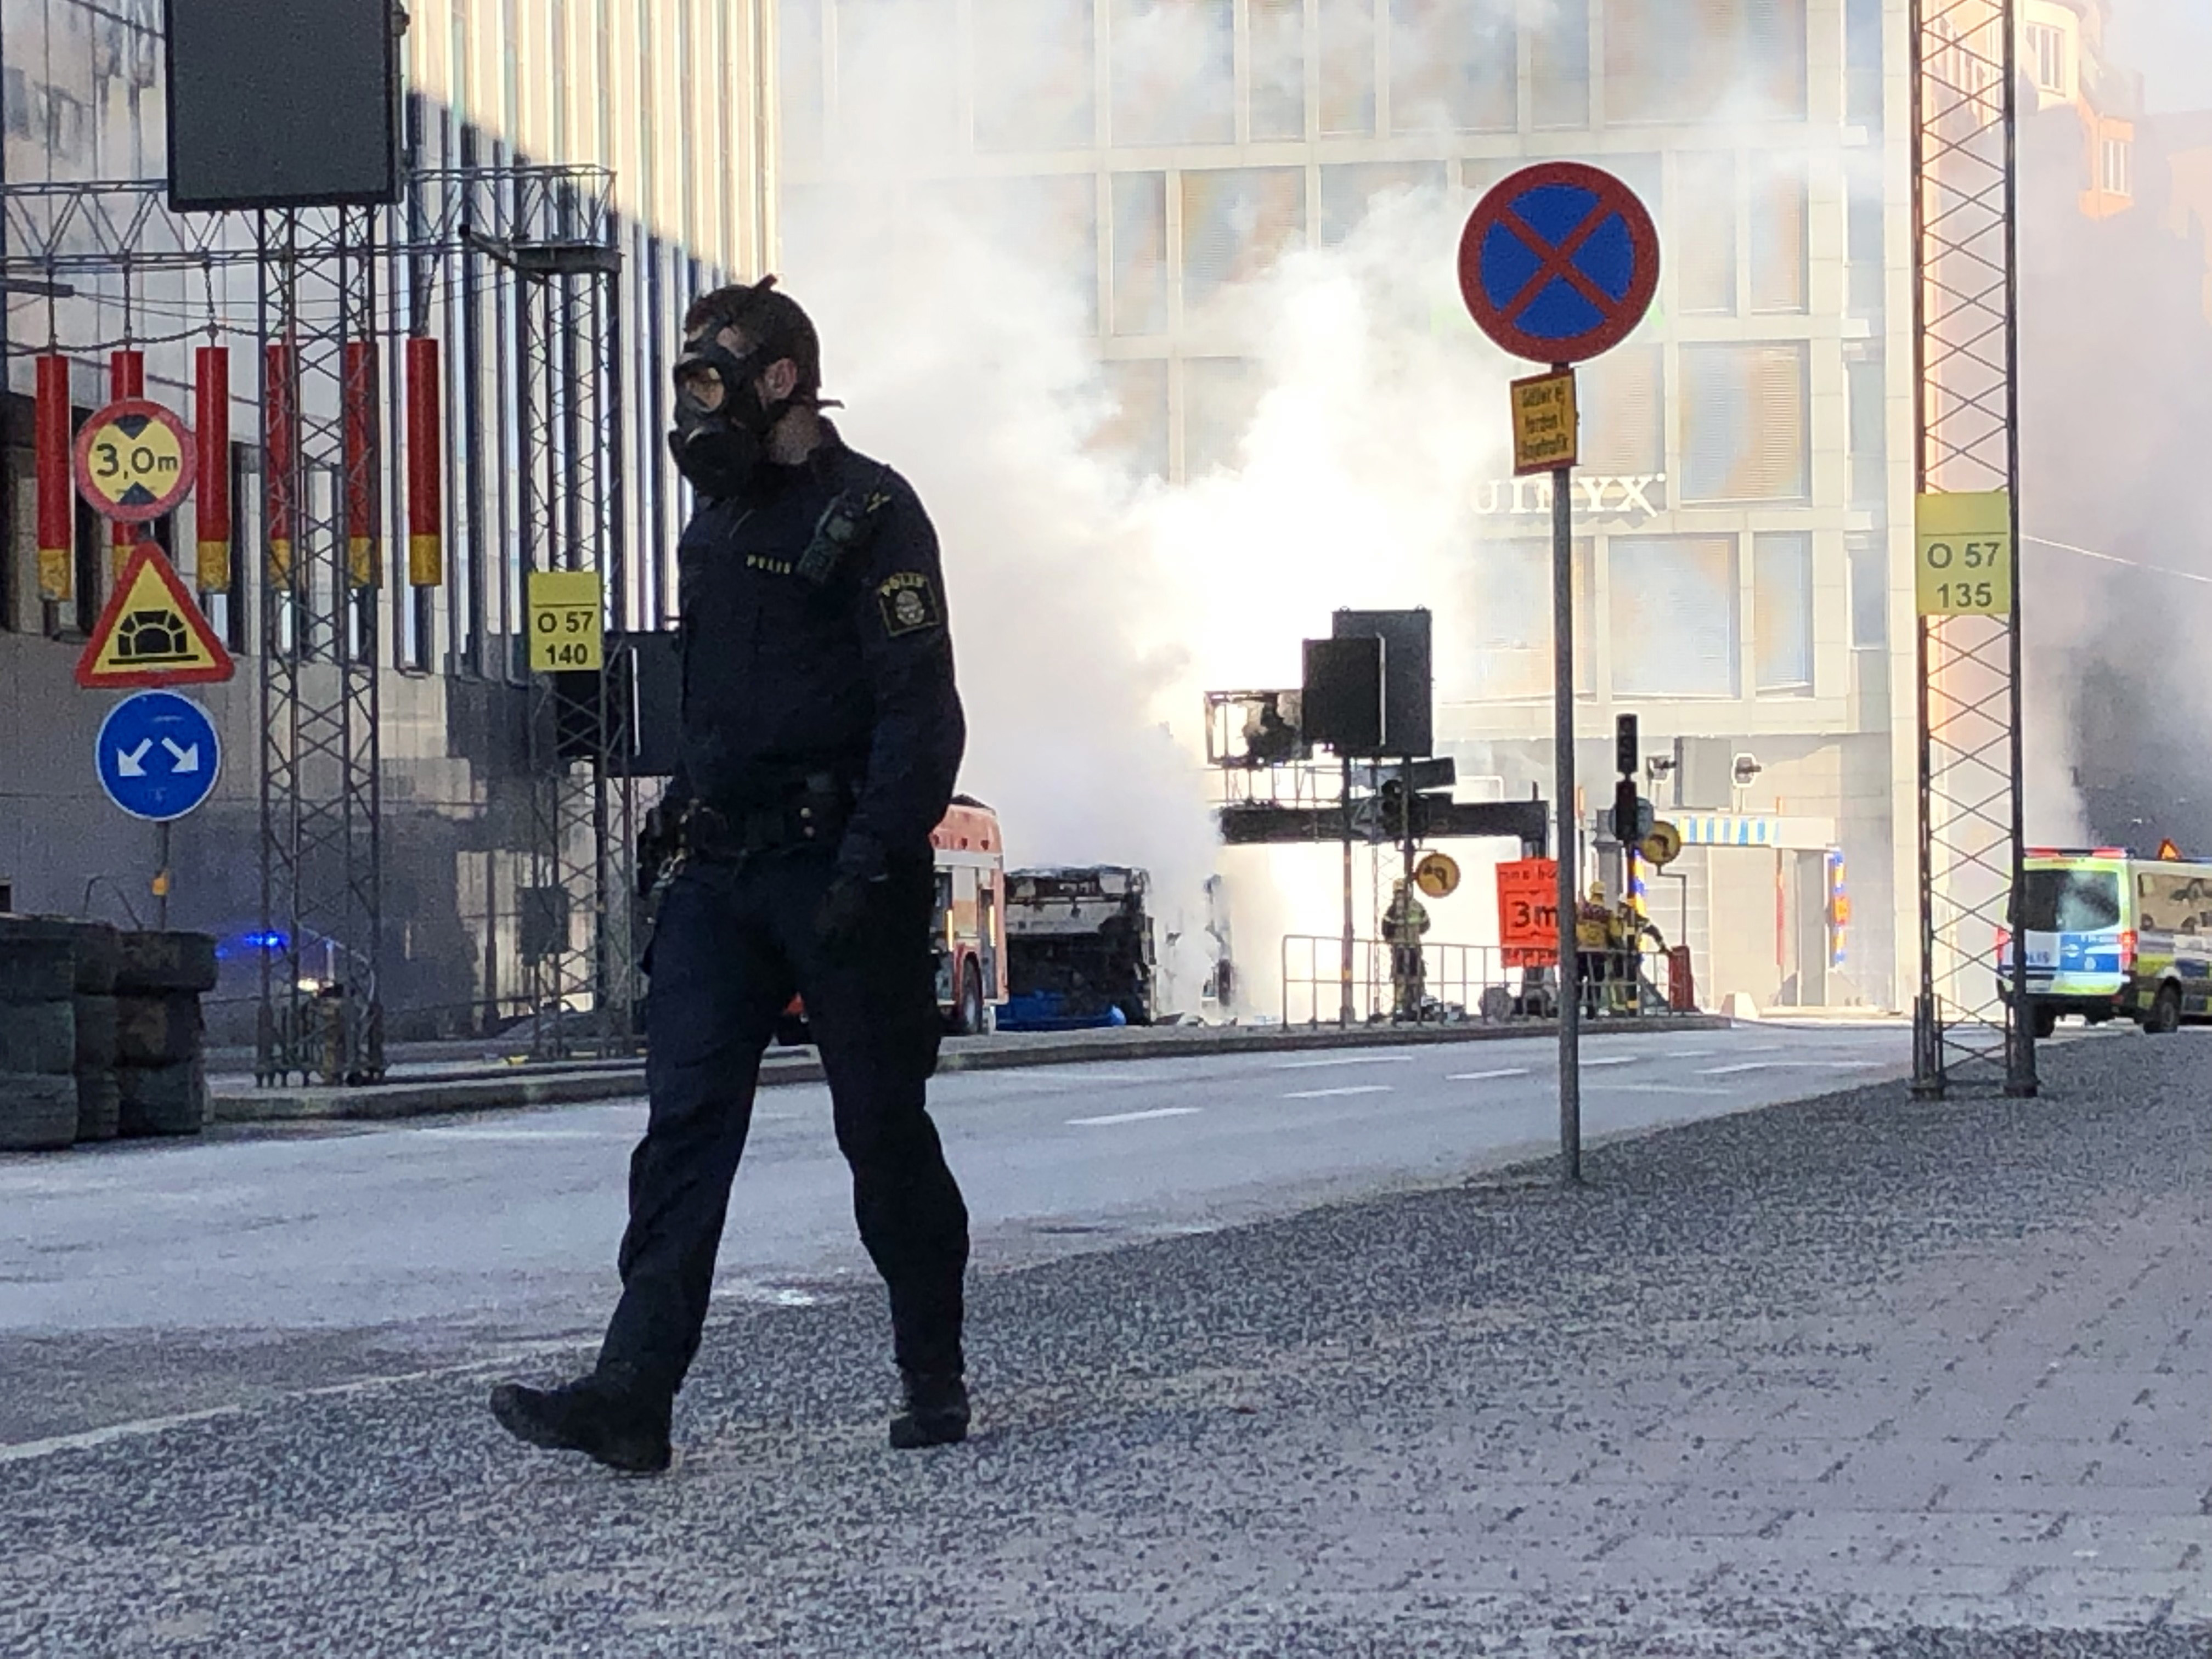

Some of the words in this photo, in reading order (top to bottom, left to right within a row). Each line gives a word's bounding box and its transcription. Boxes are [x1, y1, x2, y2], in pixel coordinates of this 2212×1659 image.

[1927, 543, 1953, 569] O
[1965, 541, 2001, 568] 57
[1937, 582, 1993, 608] 135
[537, 612, 557, 633] O
[566, 611, 594, 633] 57
[545, 642, 588, 665] 140
